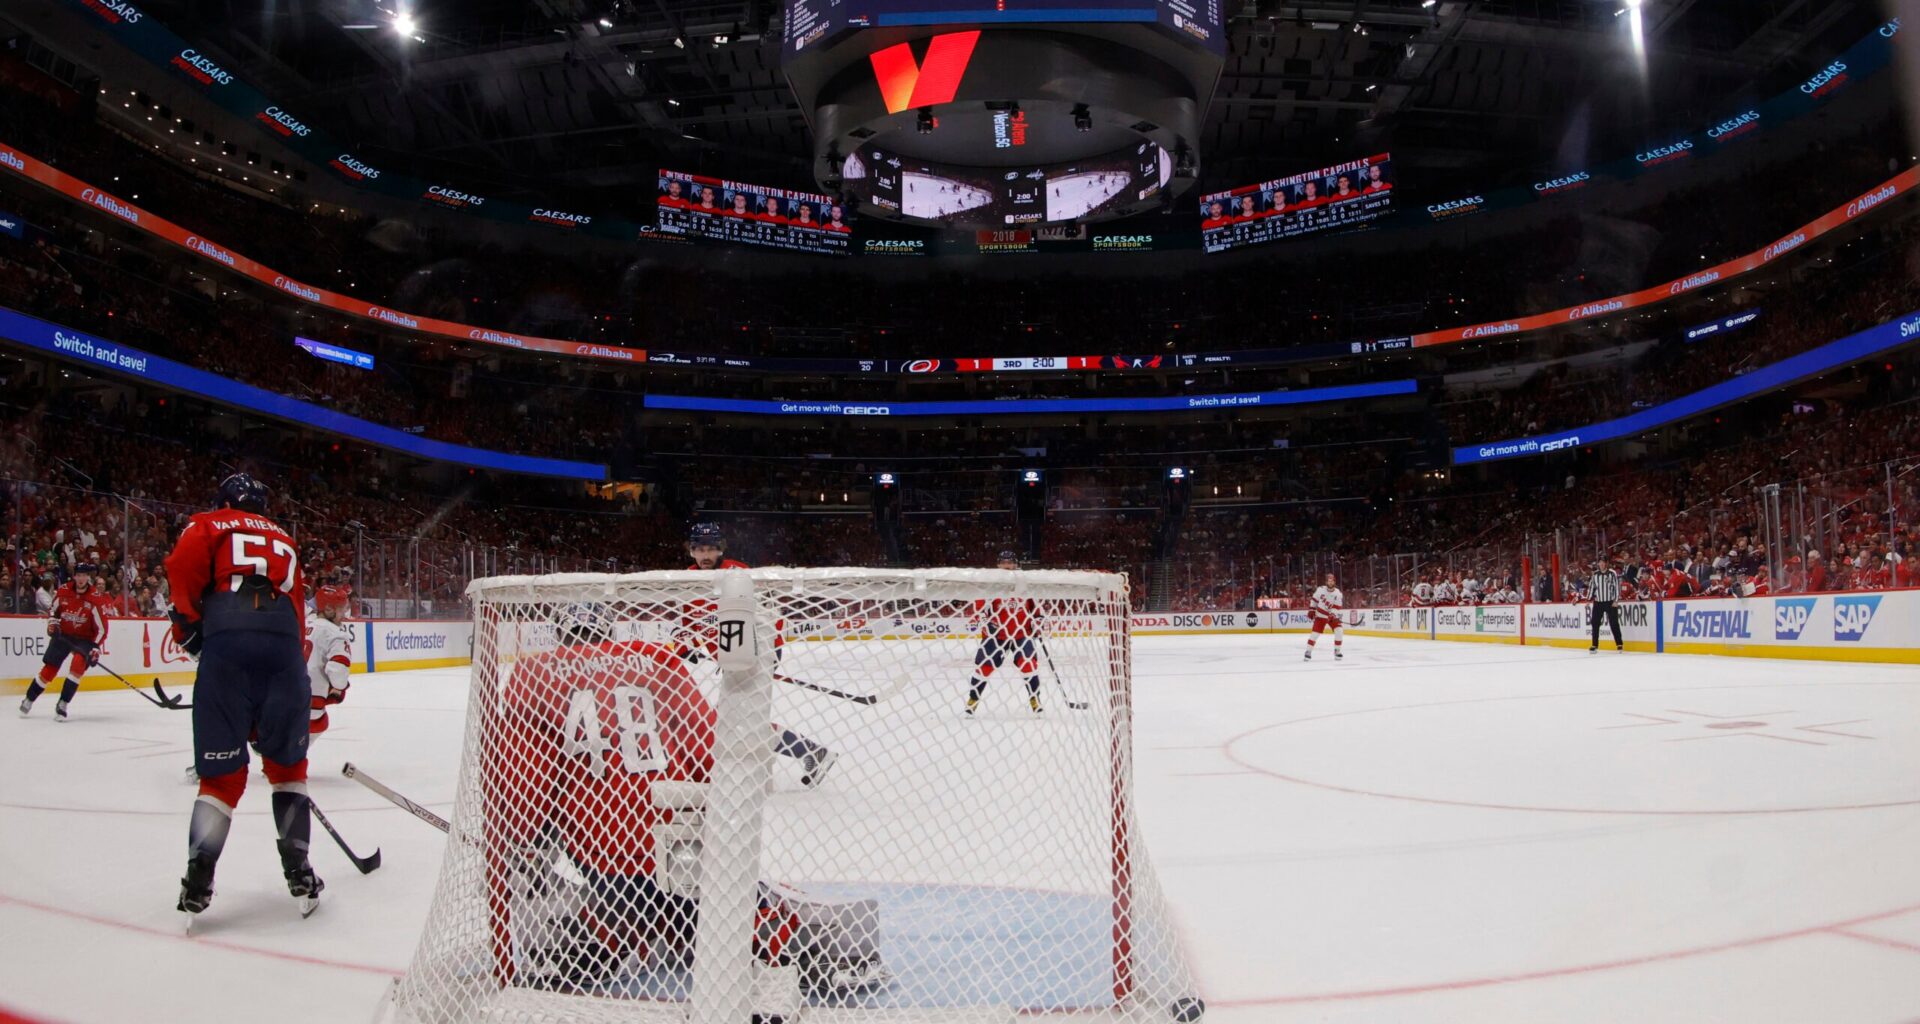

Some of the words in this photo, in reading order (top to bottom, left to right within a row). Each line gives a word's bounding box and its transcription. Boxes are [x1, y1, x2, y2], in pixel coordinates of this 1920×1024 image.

[181, 49, 233, 86] CAESARS
[1800, 60, 1847, 94] CAESARS
[265, 106, 311, 137] CAESARS
[993, 113, 1009, 137] Verizon
[1707, 110, 1760, 138] CAESARS
[995, 138, 1010, 148] 5G
[1012, 123, 1029, 145] Arena
[1636, 140, 1693, 163] CAESARS
[338, 154, 380, 179] CAESARS
[675, 172, 684, 180] THE
[1260, 171, 1320, 191] WASHINGTON
[1323, 158, 1369, 177] CAPITALS
[1534, 171, 1590, 192] CAESARS
[428, 185, 485, 206] CAESARS
[722, 180, 784, 198] WASHINGTON
[787, 190, 832, 204] CAPITALS
[1857, 184, 1896, 213] Alibaba
[94, 192, 139, 223] Alibaba
[879, 198, 898, 208] CAESARS
[1366, 201, 1381, 209] SAVES
[1427, 195, 1484, 213] CAESARS
[533, 208, 591, 225] CAESARS
[865, 239, 924, 247] CAESARS
[993, 231, 1015, 242] 2018
[1093, 235, 1152, 243] CAESARS
[1773, 232, 1805, 256] Alibaba
[197, 240, 234, 265] Alibaba
[284, 279, 320, 301] Alibaba
[1681, 271, 1719, 291] Alibaba
[1581, 299, 1623, 317] Alibaba
[379, 309, 417, 328] Alibaba
[482, 331, 522, 347] Alibaba
[1475, 322, 1519, 337] Alibaba
[54, 331, 94, 357] Switch
[95, 348, 117, 364] and
[119, 354, 147, 372] save!
[590, 346, 633, 360] Alibaba
[973, 360, 979, 369] 1
[1033, 358, 1055, 367] 2:00
[1081, 358, 1087, 367] 1
[781, 404, 797, 412] Get
[822, 404, 841, 412] with
[843, 407, 889, 415] GEICO
[1189, 397, 1219, 407] Switch
[1221, 396, 1237, 405] and
[1238, 395, 1260, 404] save!
[1479, 447, 1495, 457] Get
[1496, 446, 1518, 455] more
[1519, 440, 1538, 452] with
[1540, 436, 1579, 452] GEICO
[212, 519, 240, 530] VAN
[231, 532, 297, 593] 57
[1130, 617, 1170, 627] NDA
[1173, 614, 1235, 627] DISCOVER
[1246, 615, 1258, 625] TNT
[1400, 609, 1410, 630] CAT
[1417, 609, 1427, 630] CAT
[1438, 610, 1456, 625] Great
[1456, 610, 1471, 629] Clips
[1478, 612, 1515, 628] enterprise
[1537, 612, 1581, 629] MassMutual
[1585, 603, 1648, 626] BRMOR
[1672, 603, 1752, 638] FASTENAL
[1775, 605, 1808, 633] SAP
[1834, 603, 1872, 633] SAP
[2, 637, 44, 656] TURE
[385, 630, 447, 650] ticketmaster
[548, 653, 656, 681] THOMPSON
[563, 686, 668, 778] 48
[204, 747, 241, 761] CCM
